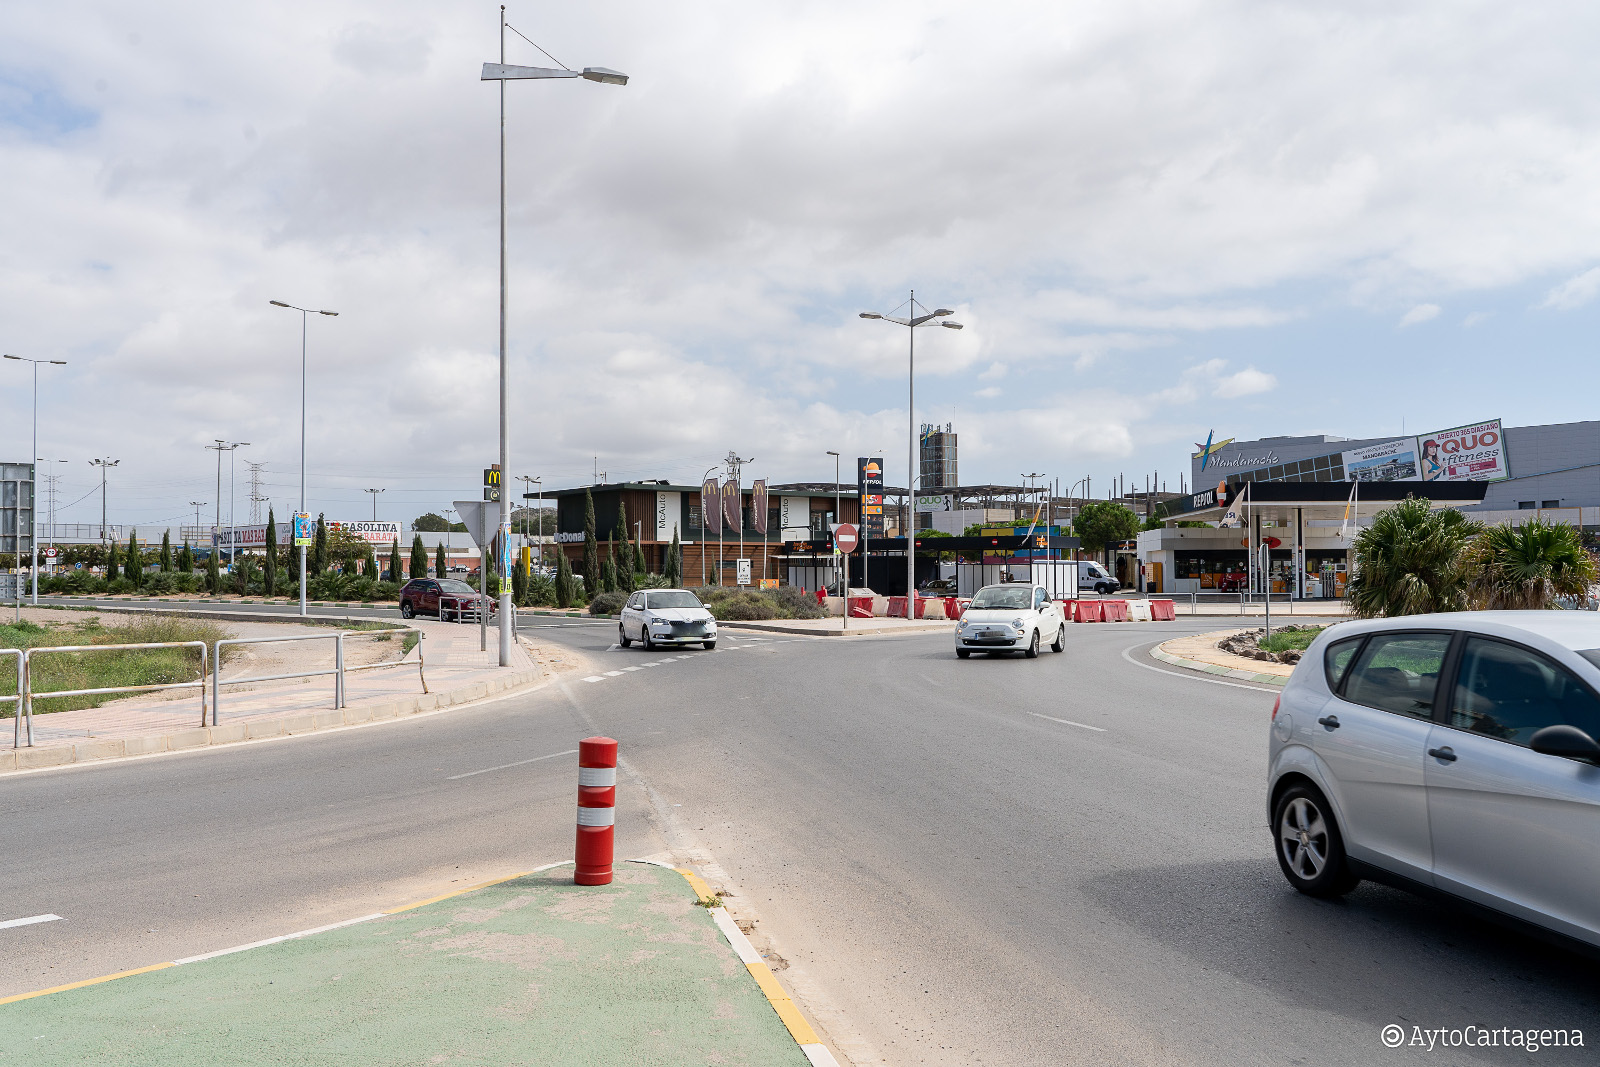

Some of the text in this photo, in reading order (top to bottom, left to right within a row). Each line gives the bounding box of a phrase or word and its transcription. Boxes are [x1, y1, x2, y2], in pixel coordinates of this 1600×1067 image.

[1437, 430, 1460, 441] ABIERTO
[1460, 429, 1471, 437] 365
[1441, 431, 1499, 454] QUO
[1209, 450, 1279, 468] Mandarache
[1447, 449, 1500, 465] fitness
[919, 496, 942, 505] QUO
[1193, 491, 1213, 508] REPSOL
[658, 493, 666, 529] McAuto
[342, 522, 398, 533] GASOLINA
